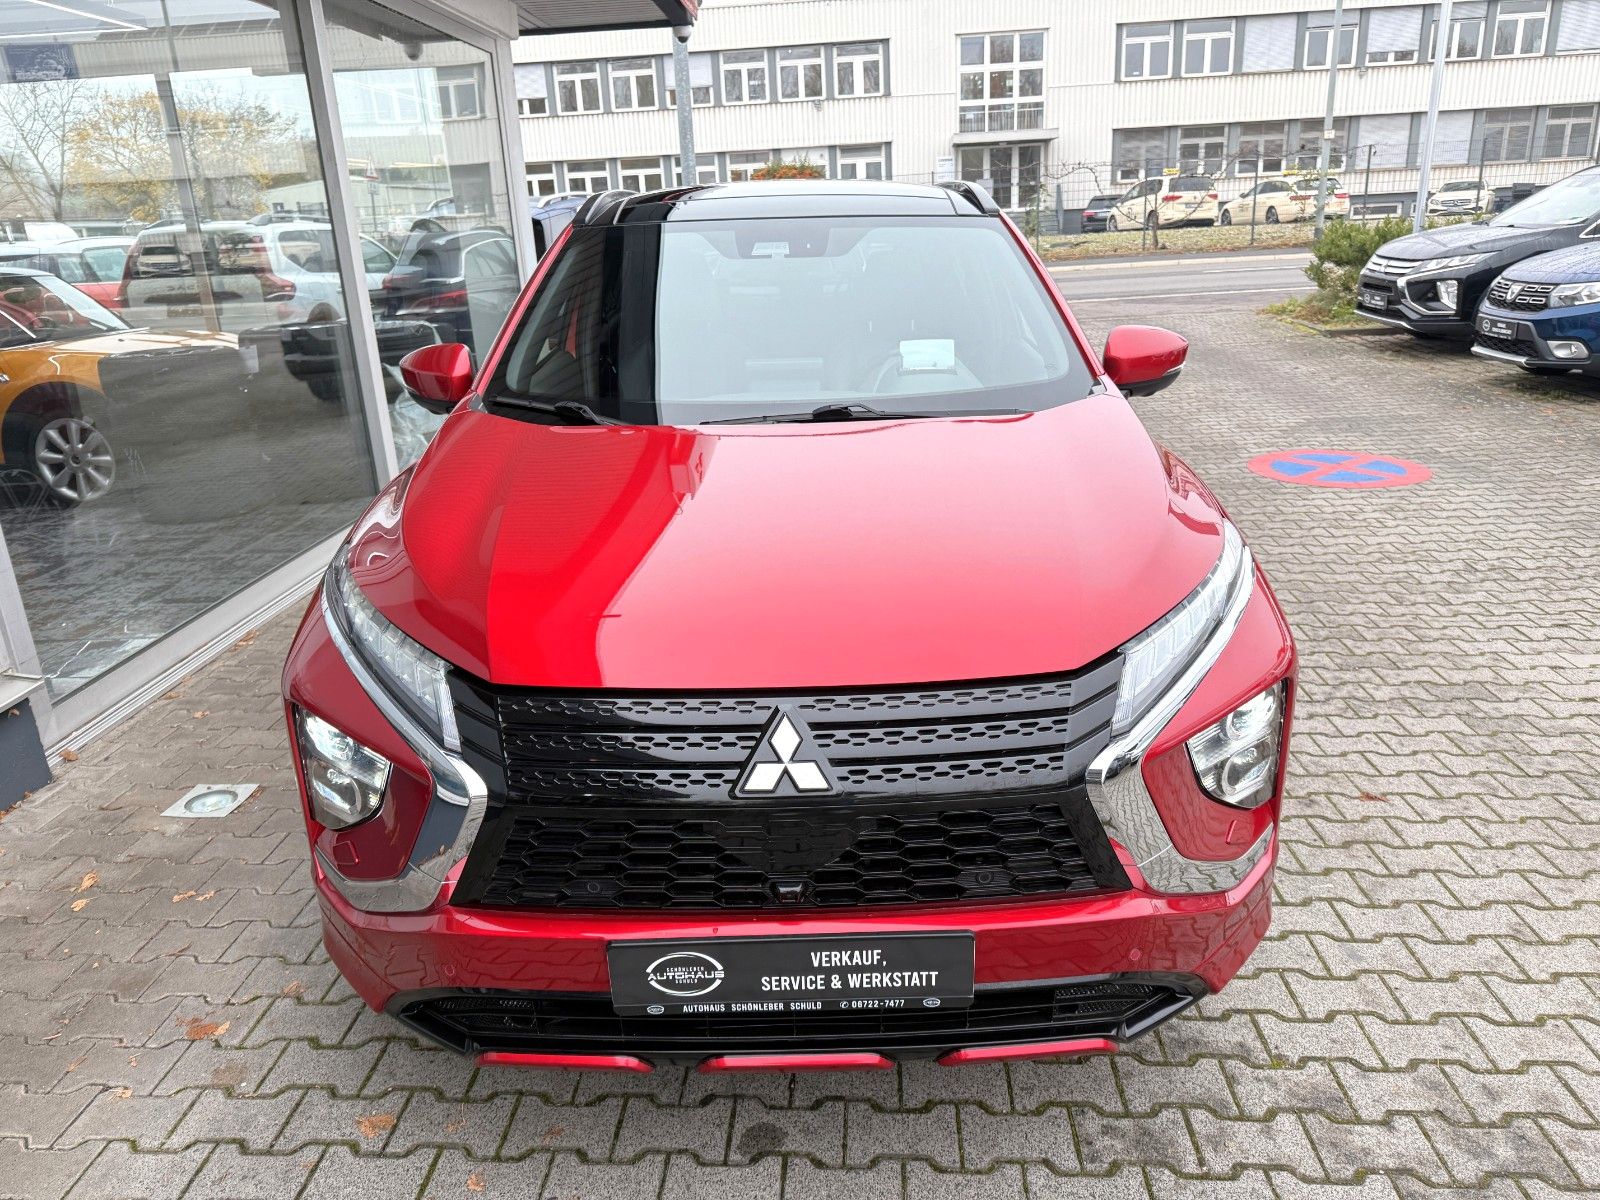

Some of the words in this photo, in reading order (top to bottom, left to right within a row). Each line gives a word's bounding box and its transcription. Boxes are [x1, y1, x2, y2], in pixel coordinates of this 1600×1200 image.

[810, 949, 888, 968] VERKAUF,
[647, 970, 725, 981] AUTOHAUS
[760, 974, 826, 991] SERVICE
[830, 973, 843, 990] &
[847, 971, 939, 989] WERKSTATT
[683, 1004, 726, 1013] AUTOHAUS
[731, 1002, 784, 1012] SCHÖNLEBER
[789, 1001, 822, 1010] SCHULD
